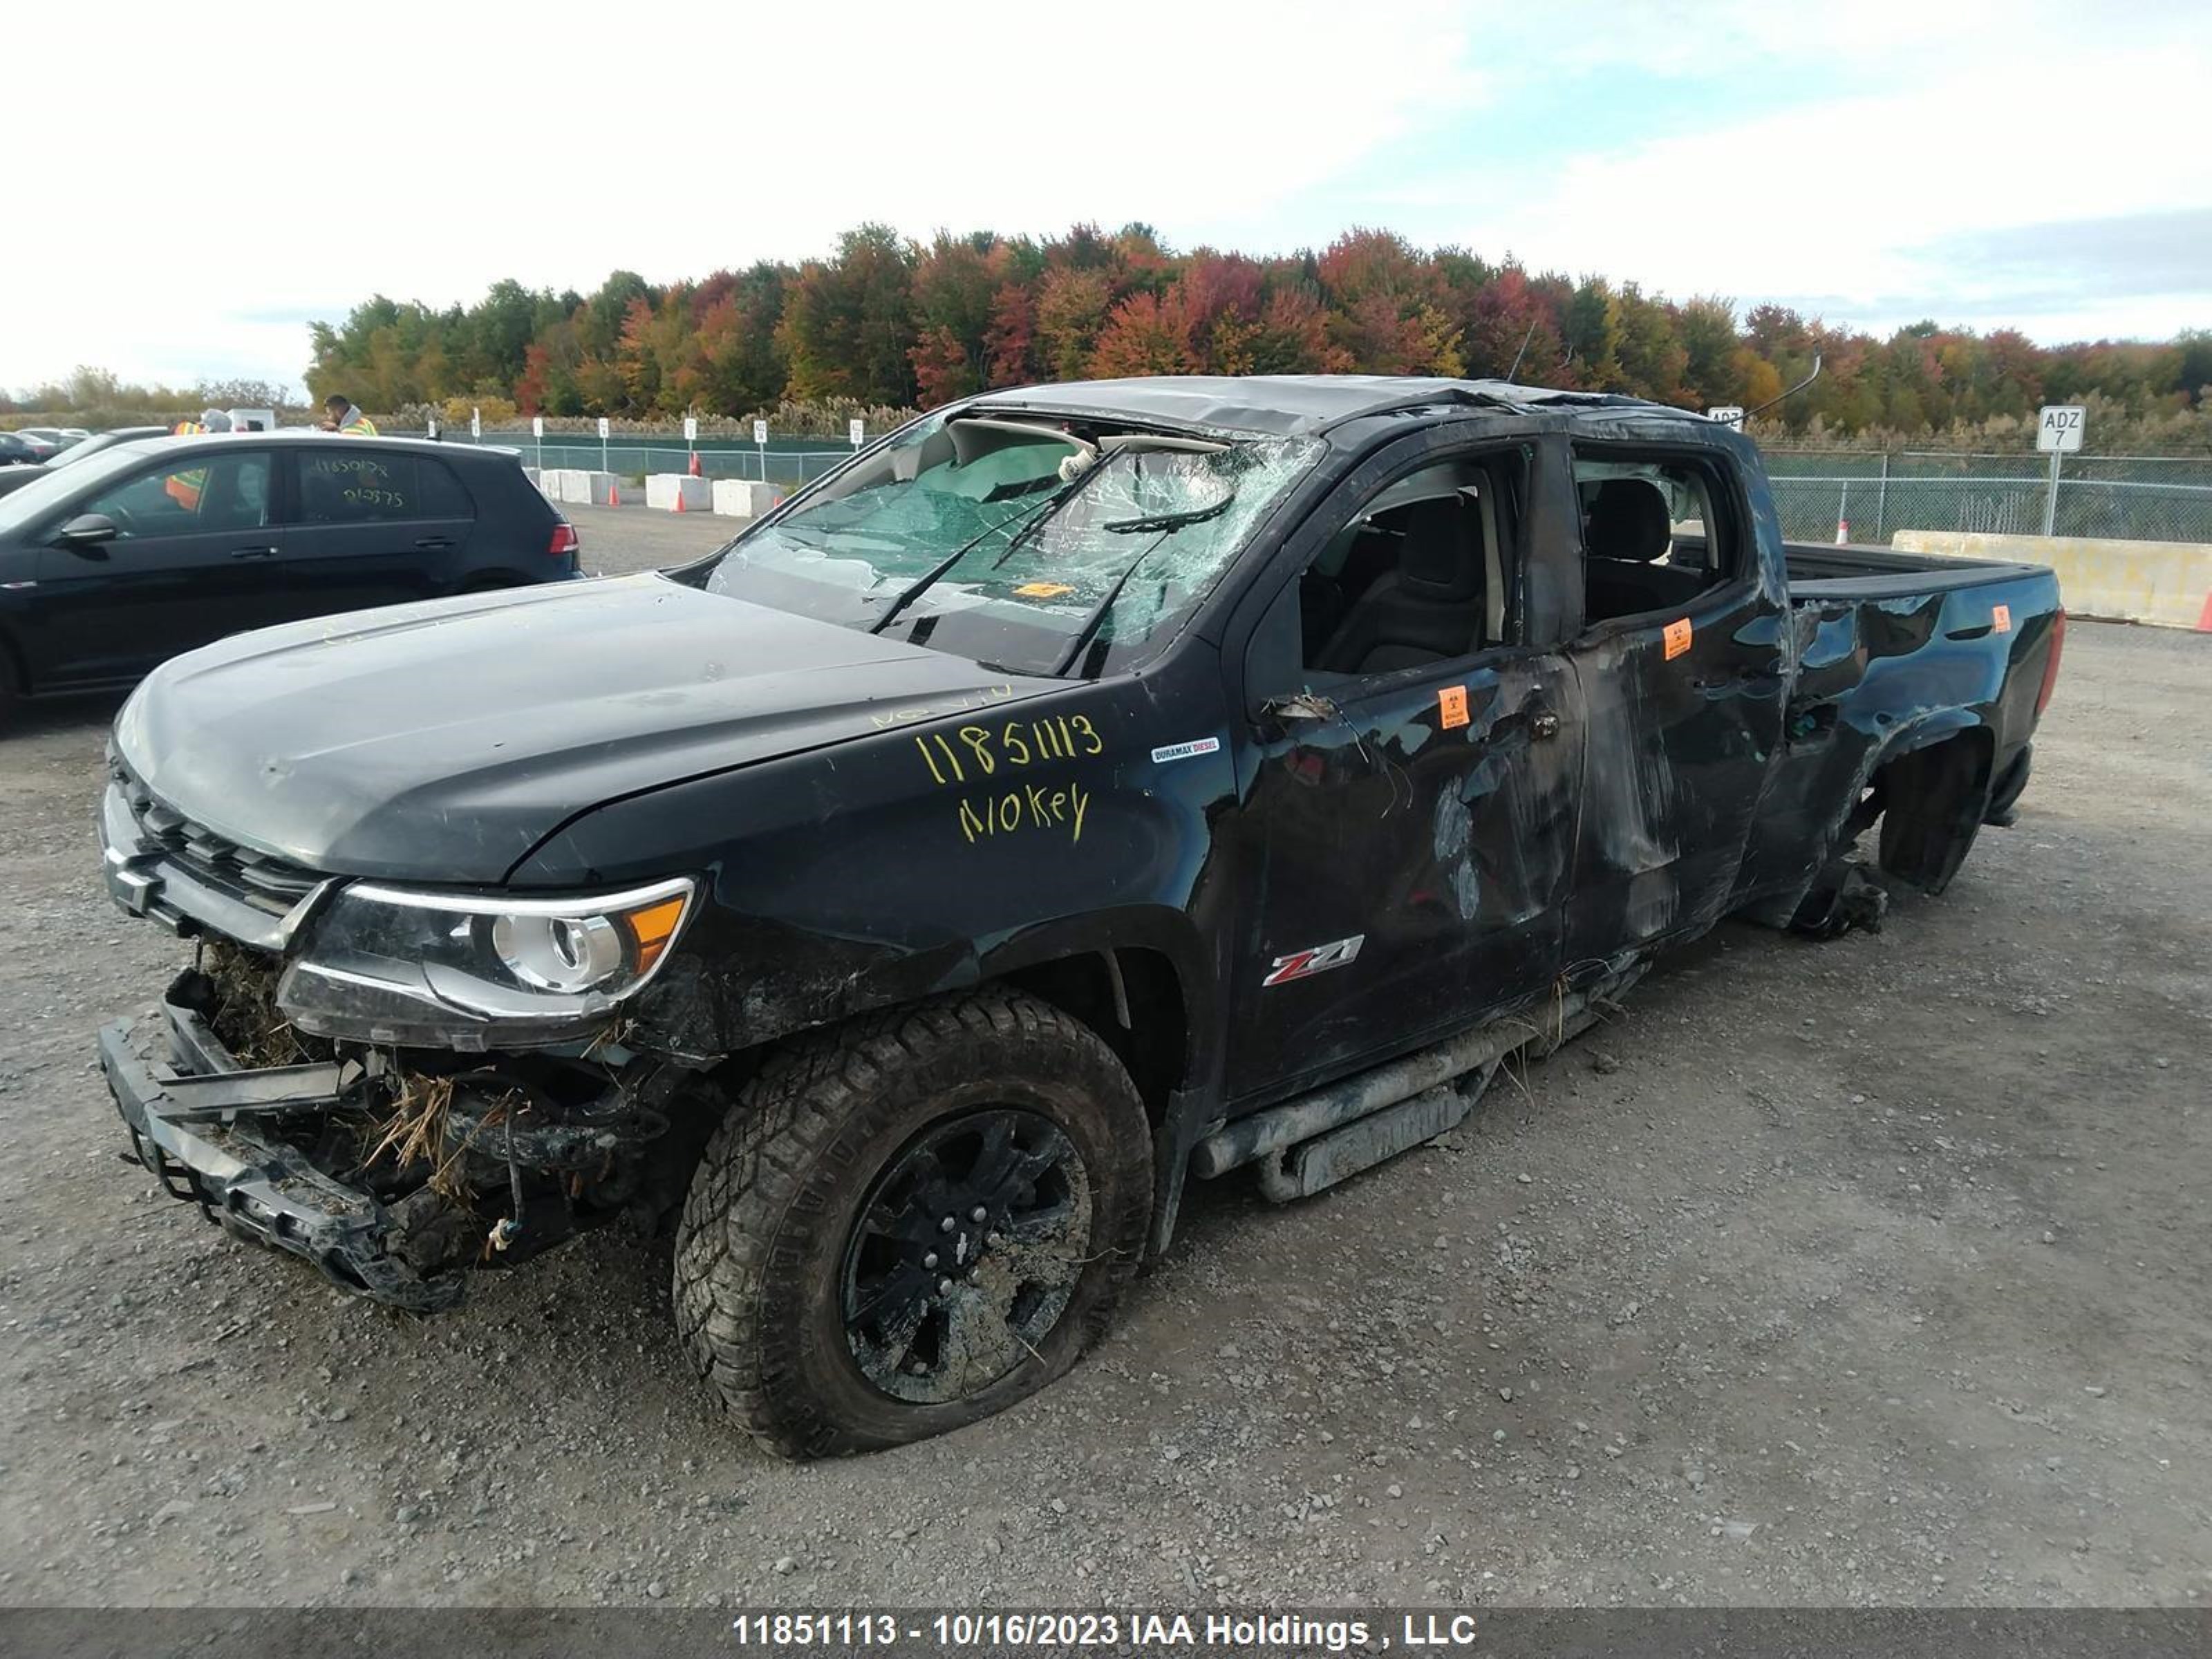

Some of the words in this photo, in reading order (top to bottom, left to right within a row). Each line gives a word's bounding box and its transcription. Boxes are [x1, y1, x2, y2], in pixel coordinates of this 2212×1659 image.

[2045, 412, 2079, 429] ADZ
[2055, 430, 2065, 446] 7
[915, 714, 1103, 785] 11851113
[1154, 745, 1194, 760] DURAMAX
[1192, 740, 1217, 752] DIESEL
[1262, 933, 1365, 987] Z71
